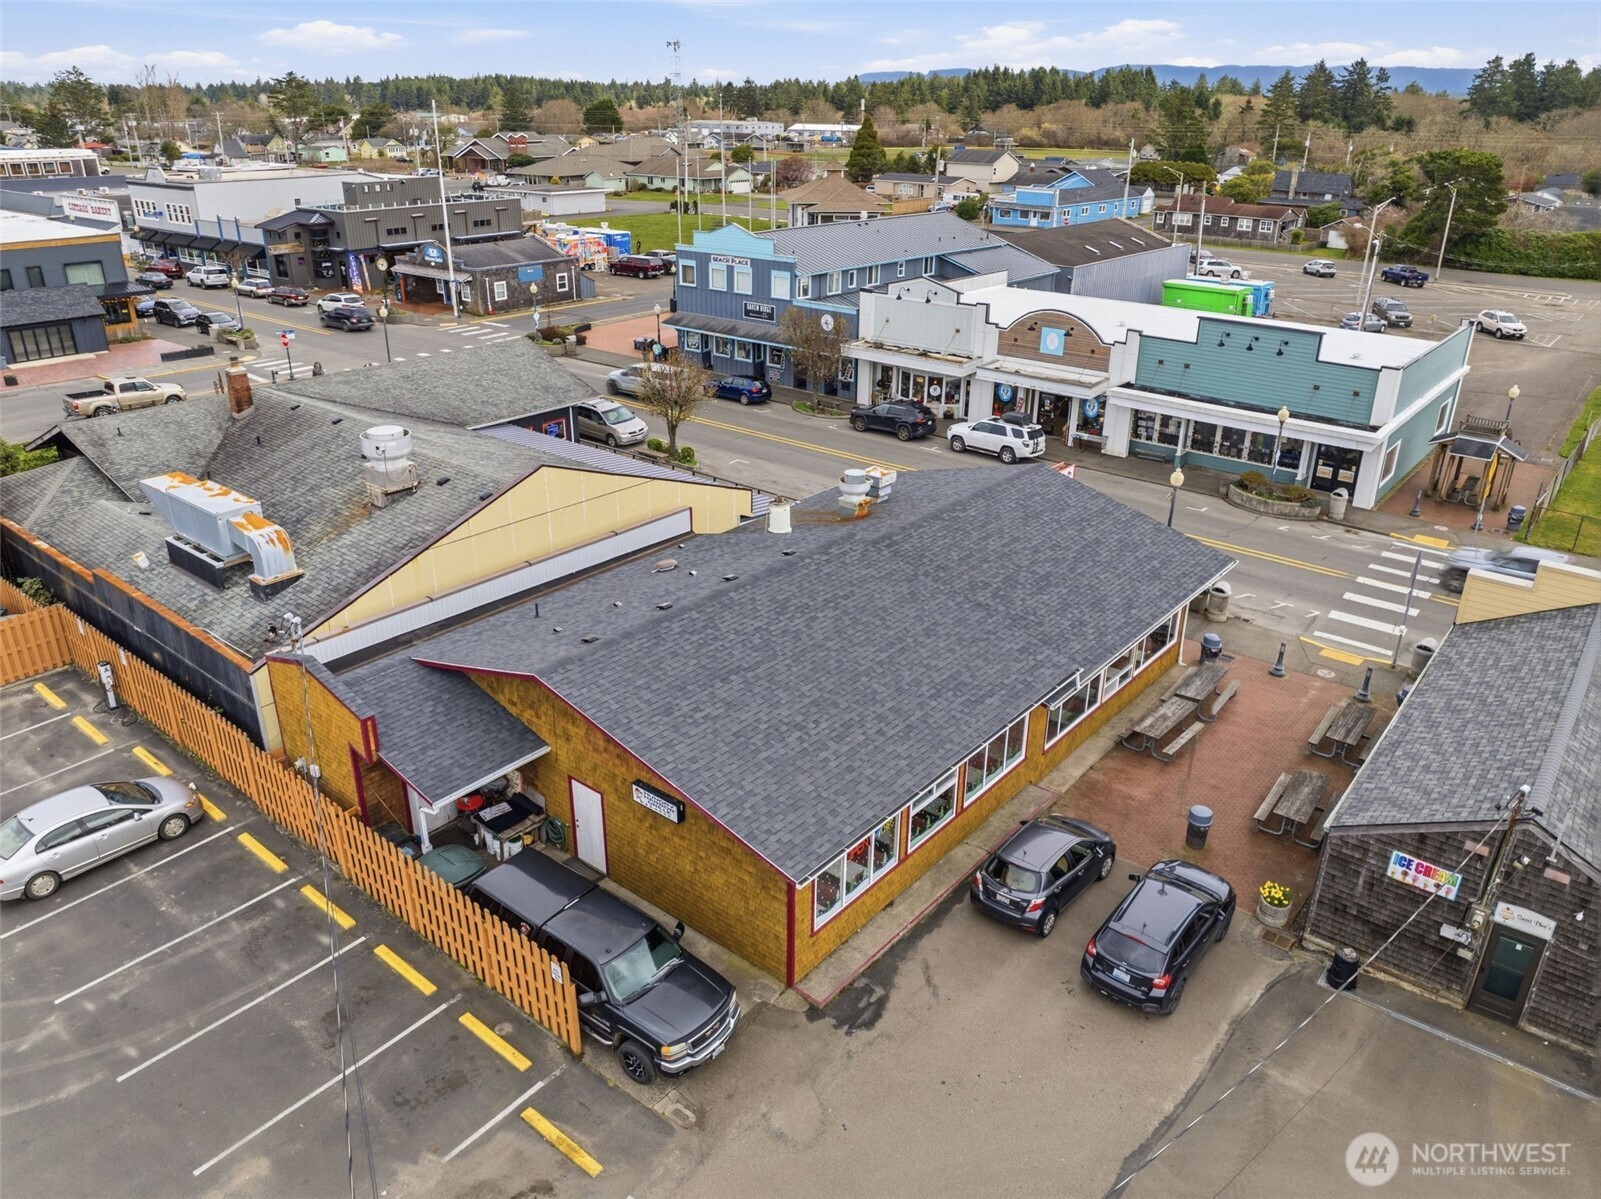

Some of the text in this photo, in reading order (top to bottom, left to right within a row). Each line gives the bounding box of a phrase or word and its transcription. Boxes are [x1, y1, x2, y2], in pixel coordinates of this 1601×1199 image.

[90, 205, 112, 216] BAKERY
[712, 256, 749, 266] BEACH PLACE
[1393, 853, 1459, 887] ICE CREAM
